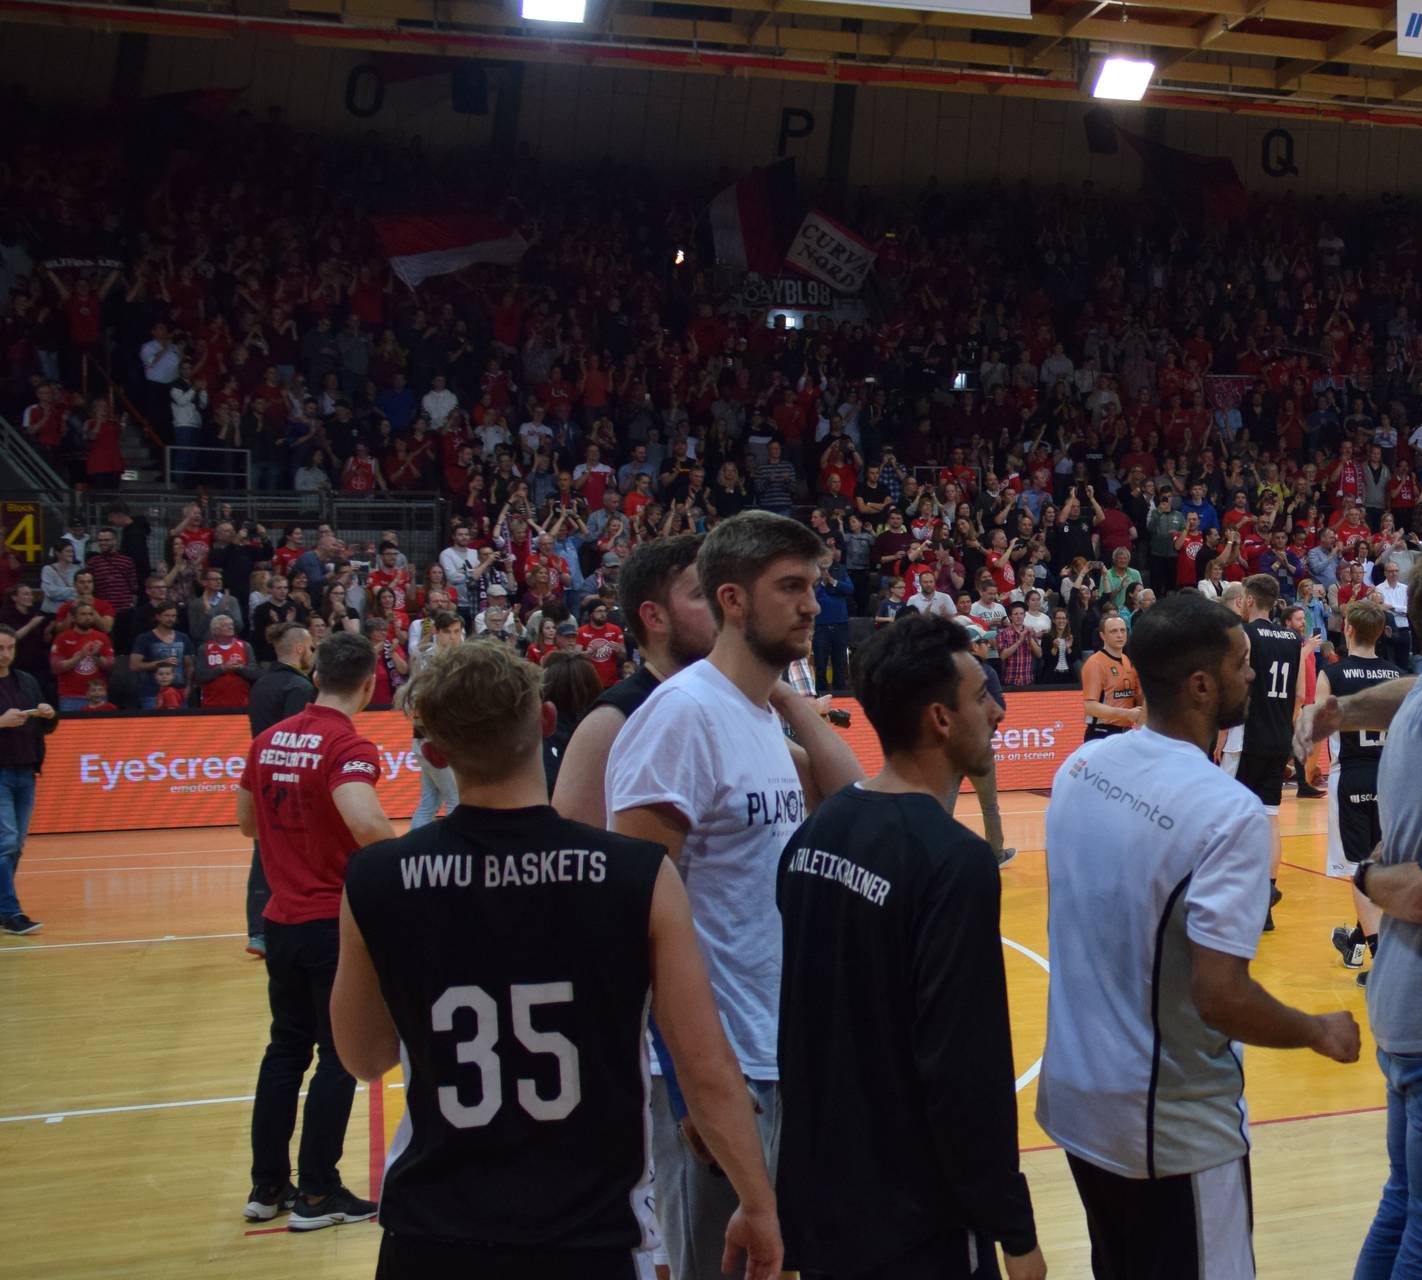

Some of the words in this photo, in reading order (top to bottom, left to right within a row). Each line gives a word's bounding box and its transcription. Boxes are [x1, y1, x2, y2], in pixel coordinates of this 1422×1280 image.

[778, 107, 814, 157] P
[1262, 128, 1297, 177] Q
[797, 243, 856, 287] NORD
[802, 223, 872, 274] CURVA
[7, 504, 35, 512] Block
[4, 513, 44, 562] 4
[1257, 628, 1273, 637] WWU
[1274, 631, 1296, 640] BASKETS
[1267, 661, 1290, 699] 11
[1343, 668, 1365, 679] WWU
[1366, 669, 1400, 680] BASKETS
[271, 730, 323, 749] GIANTS
[1008, 752, 1021, 760] on
[1023, 751, 1055, 760] screen
[259, 749, 324, 770] SECURITY
[170, 781, 228, 793] emotions
[1083, 765, 1174, 831] viaprinto
[401, 853, 473, 890] WWU
[484, 849, 607, 888] BASKETS
[431, 980, 582, 1129] 35
